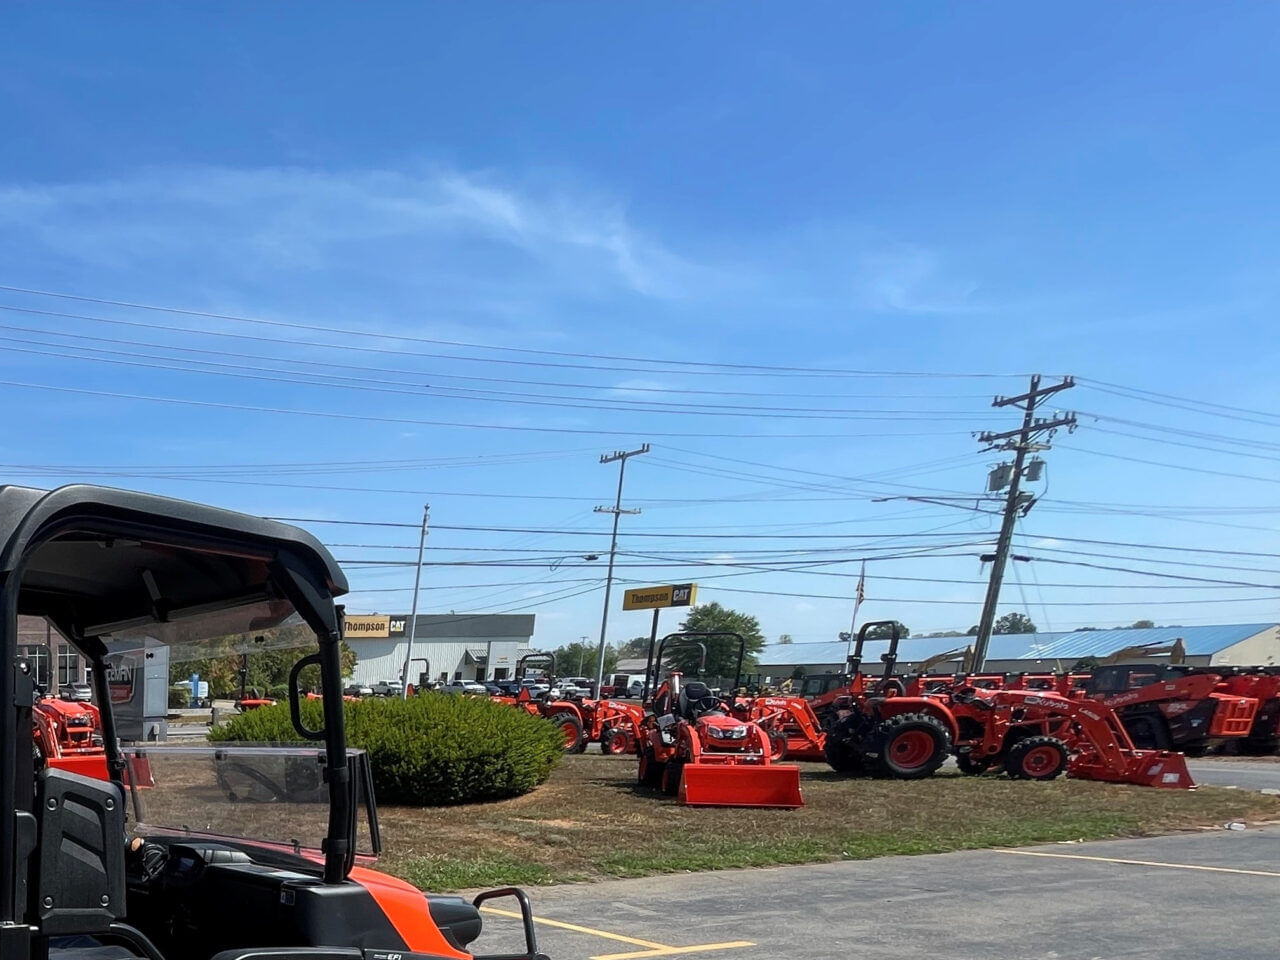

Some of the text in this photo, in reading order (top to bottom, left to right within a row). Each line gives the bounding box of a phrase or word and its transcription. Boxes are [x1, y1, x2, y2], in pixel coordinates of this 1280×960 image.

[632, 589, 690, 604] Thompson CAT
[344, 620, 406, 632] Thompson CAT
[387, 953, 402, 960] EFI
